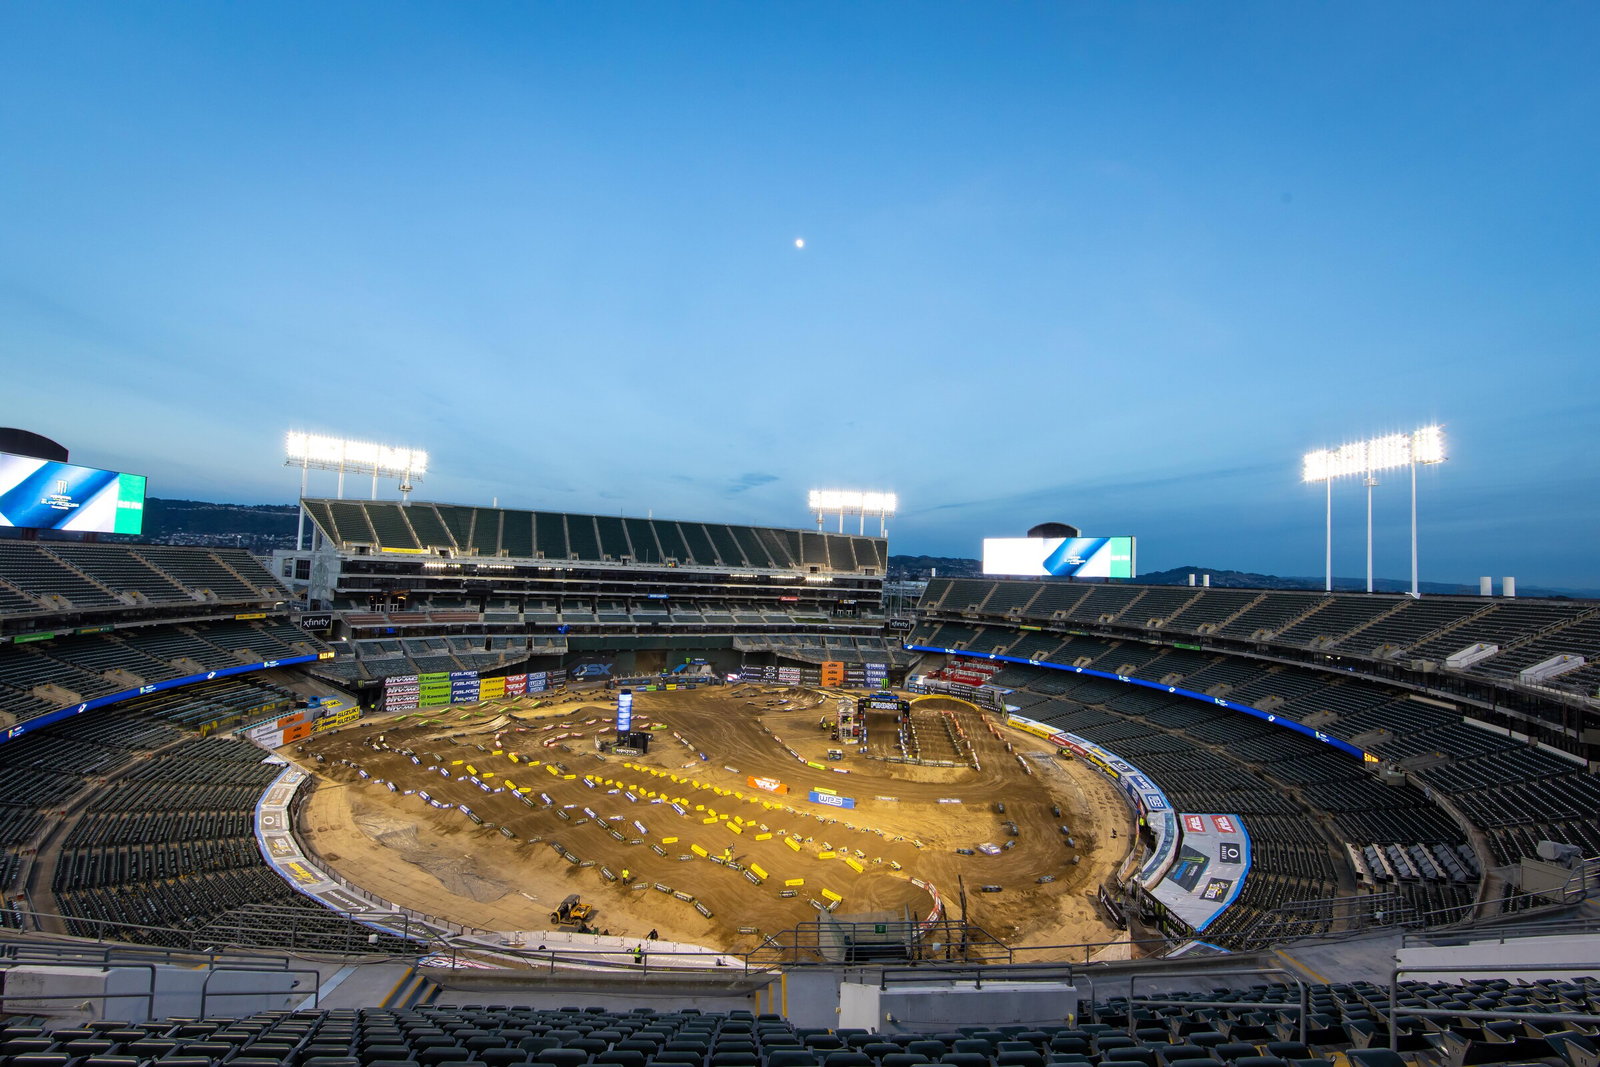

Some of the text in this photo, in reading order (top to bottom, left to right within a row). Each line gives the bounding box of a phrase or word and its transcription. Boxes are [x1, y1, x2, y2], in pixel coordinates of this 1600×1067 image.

[303, 618, 329, 628] xfinity
[891, 621, 909, 629] xfinity
[337, 706, 359, 718] SUZUKI
[337, 715, 359, 725] SUZUKI
[1032, 728, 1048, 737] DUNLOP
[754, 778, 779, 791] FLY
[818, 793, 843, 806] WPS
[1190, 815, 1203, 832] FLY
[1217, 816, 1234, 833] FLY
